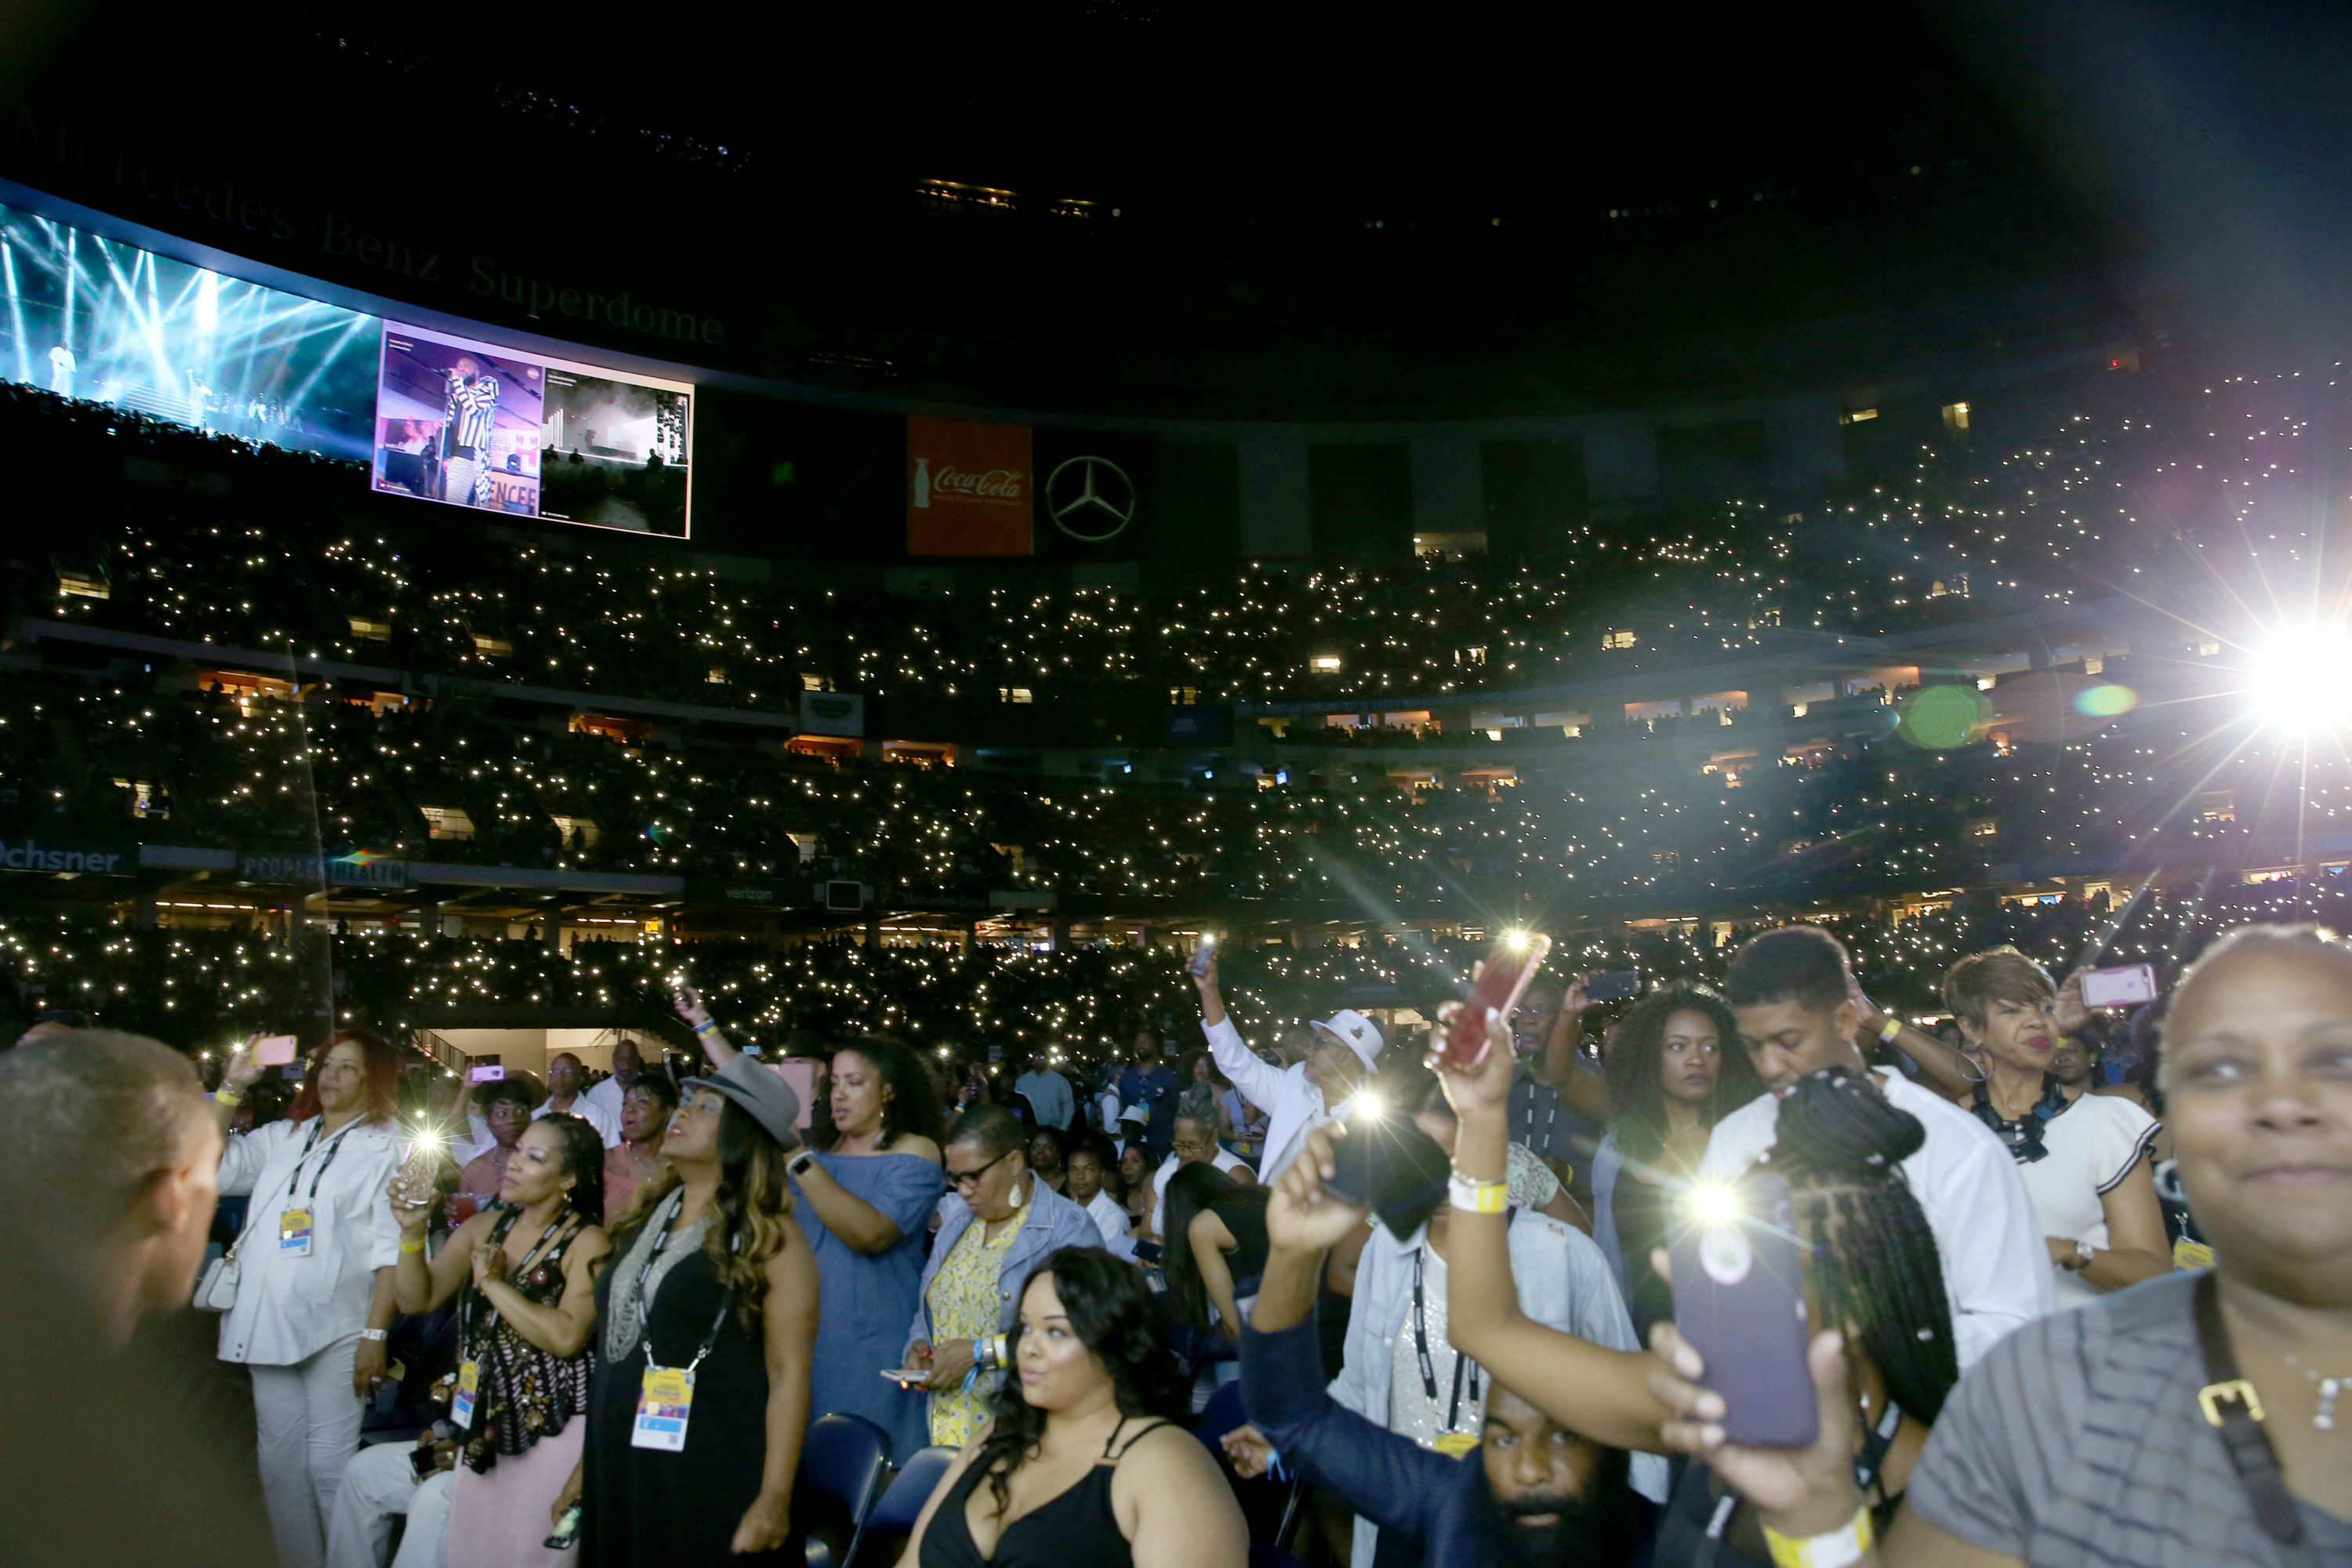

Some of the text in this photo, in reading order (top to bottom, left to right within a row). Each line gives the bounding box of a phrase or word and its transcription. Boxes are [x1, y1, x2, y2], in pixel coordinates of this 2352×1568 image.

[6, 102, 724, 345] Mercedes-Benz Superdome
[725, 888, 773, 900] verizon
